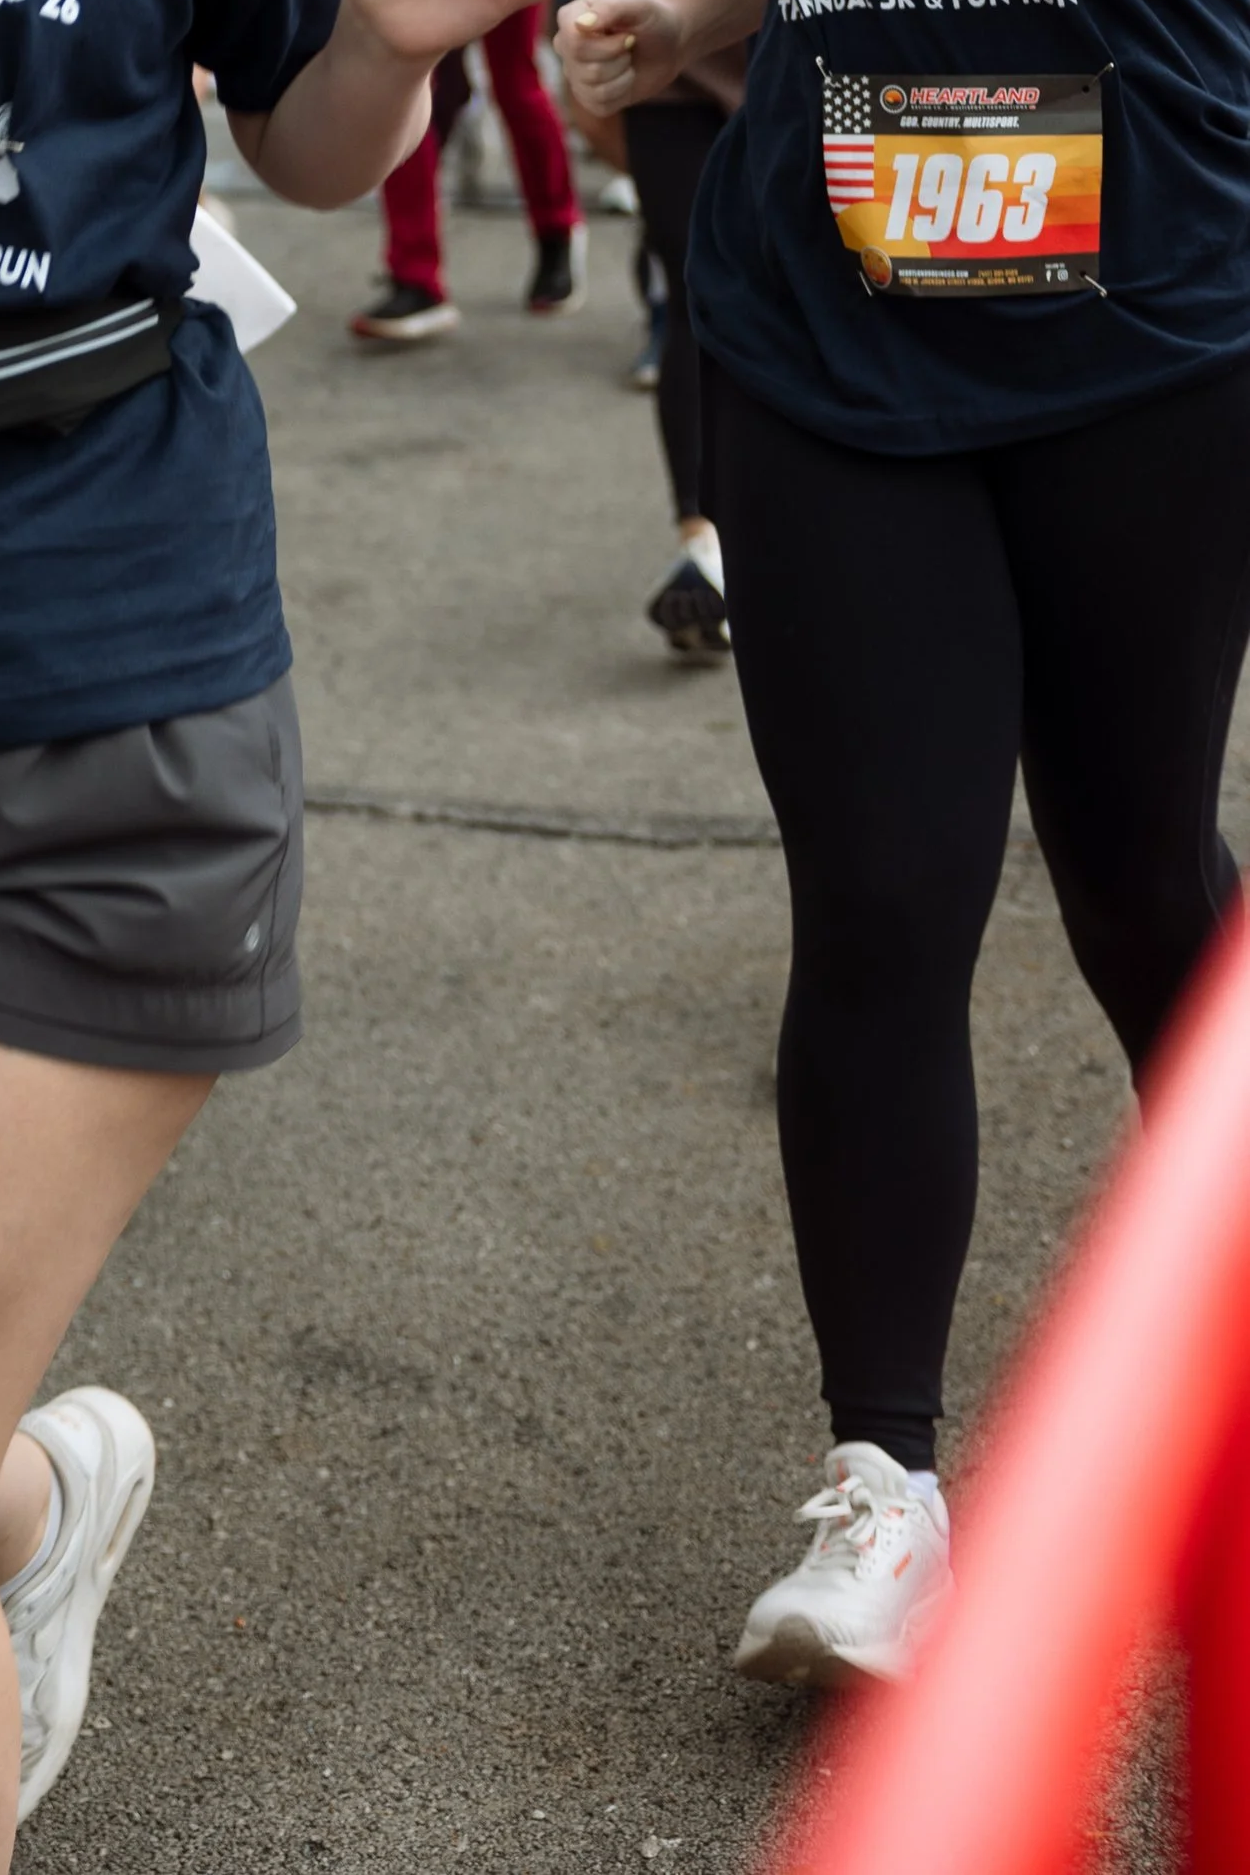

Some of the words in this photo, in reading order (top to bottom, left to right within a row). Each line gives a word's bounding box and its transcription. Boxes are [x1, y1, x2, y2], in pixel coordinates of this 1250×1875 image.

[910, 86, 1041, 106] HEARTLAND
[921, 114, 962, 129] COUNTRY.
[962, 115, 1020, 129] MULTISPORT.
[885, 154, 1057, 241] 1963
